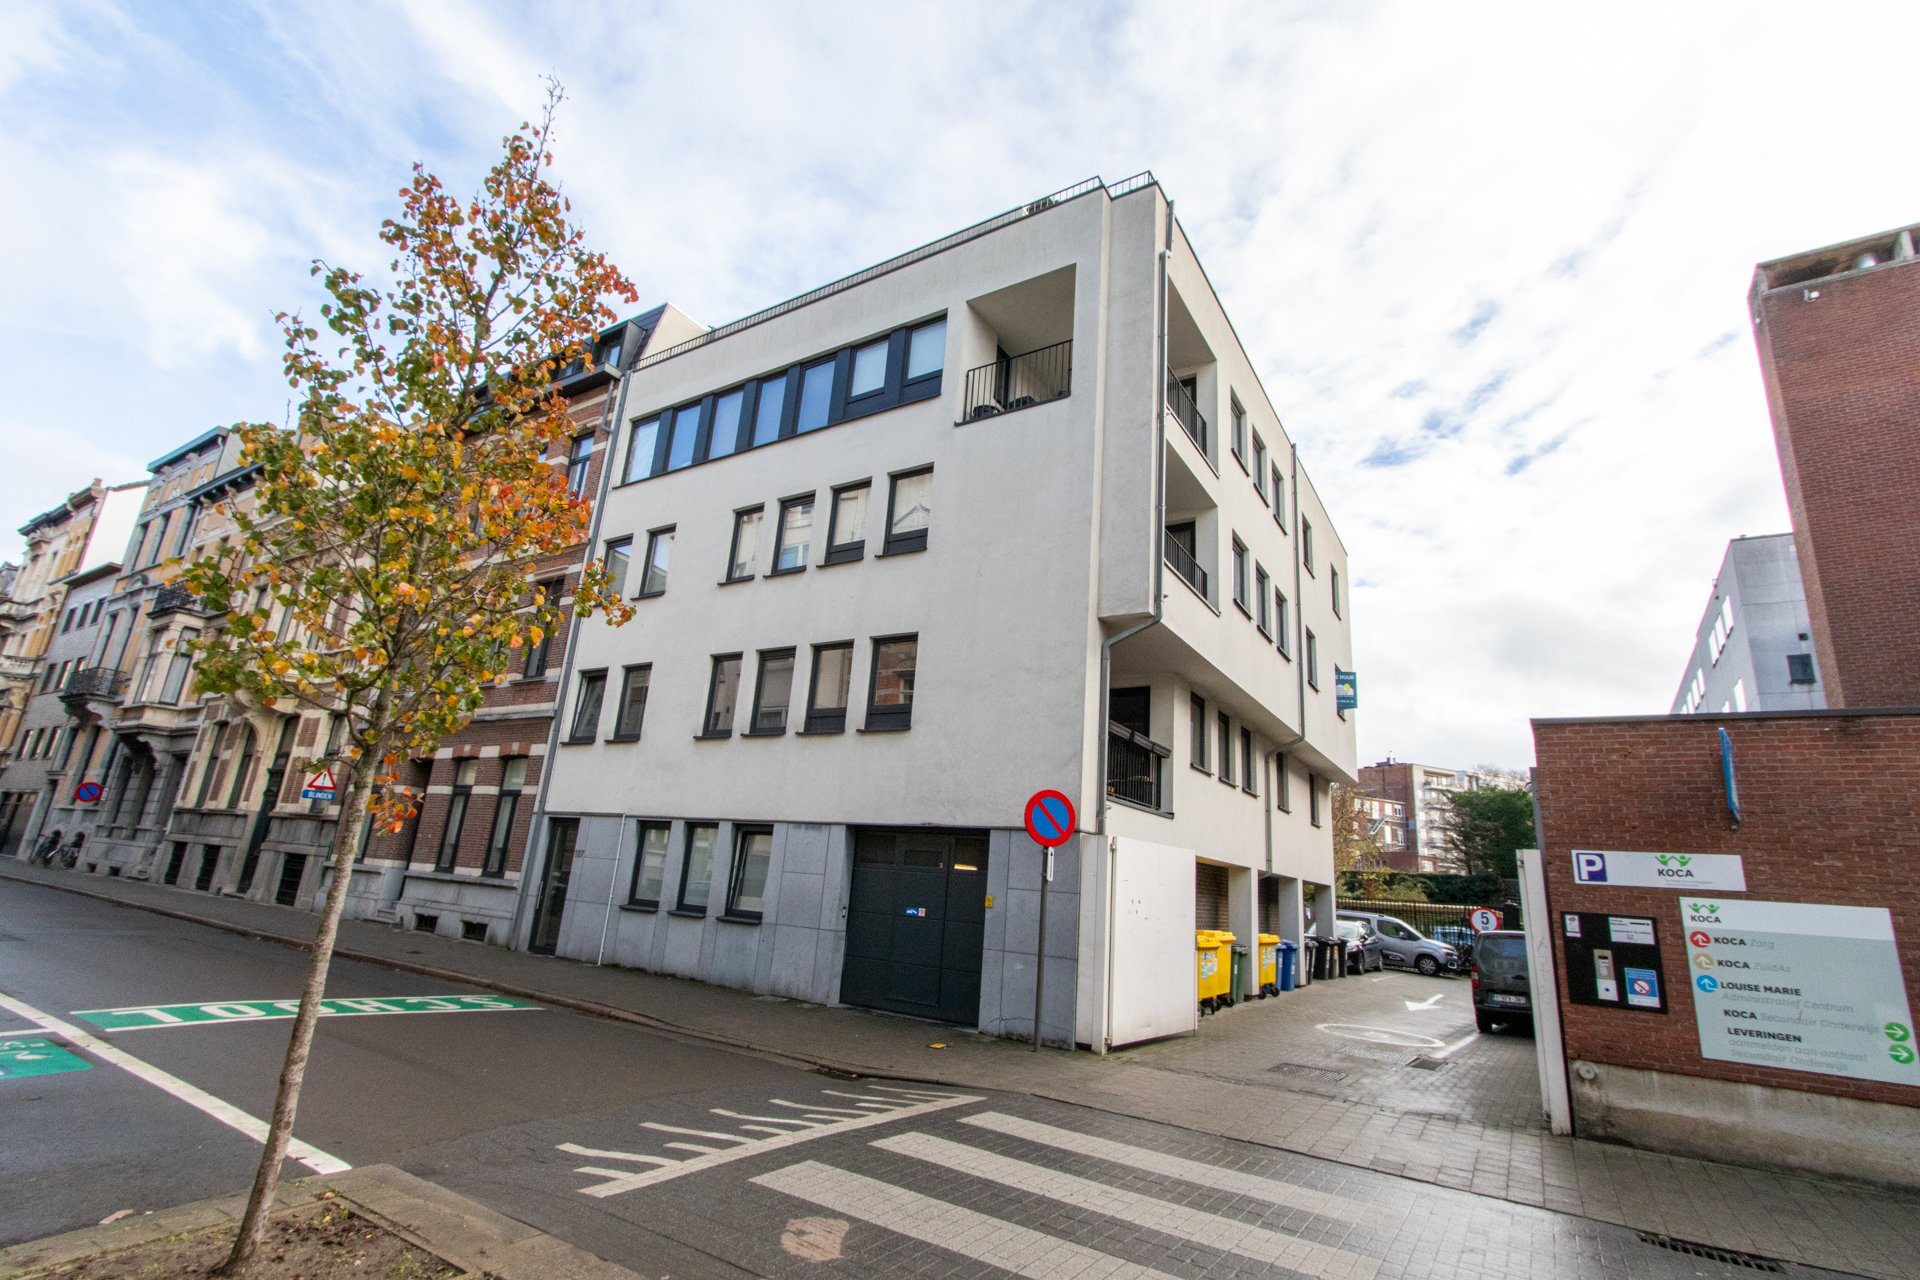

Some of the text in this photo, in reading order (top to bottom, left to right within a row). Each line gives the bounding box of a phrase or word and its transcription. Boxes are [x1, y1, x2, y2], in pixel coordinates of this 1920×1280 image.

[1578, 854, 1603, 880] P
[1657, 868, 1694, 878] KOCA
[1481, 911, 1490, 925] 5
[1690, 914, 1722, 924] KOCA
[1713, 936, 1747, 946] KOCA
[1717, 959, 1751, 970] KOCA
[1720, 981, 1801, 996] LOUISE MARIE
[111, 997, 513, 1023] SCHOOL
[1722, 992, 1854, 1014] Administratief Centrum
[1723, 1009, 1880, 1035] KOCA Secundair Onderwijs
[1727, 1027, 1802, 1043] LEVERINGEN
